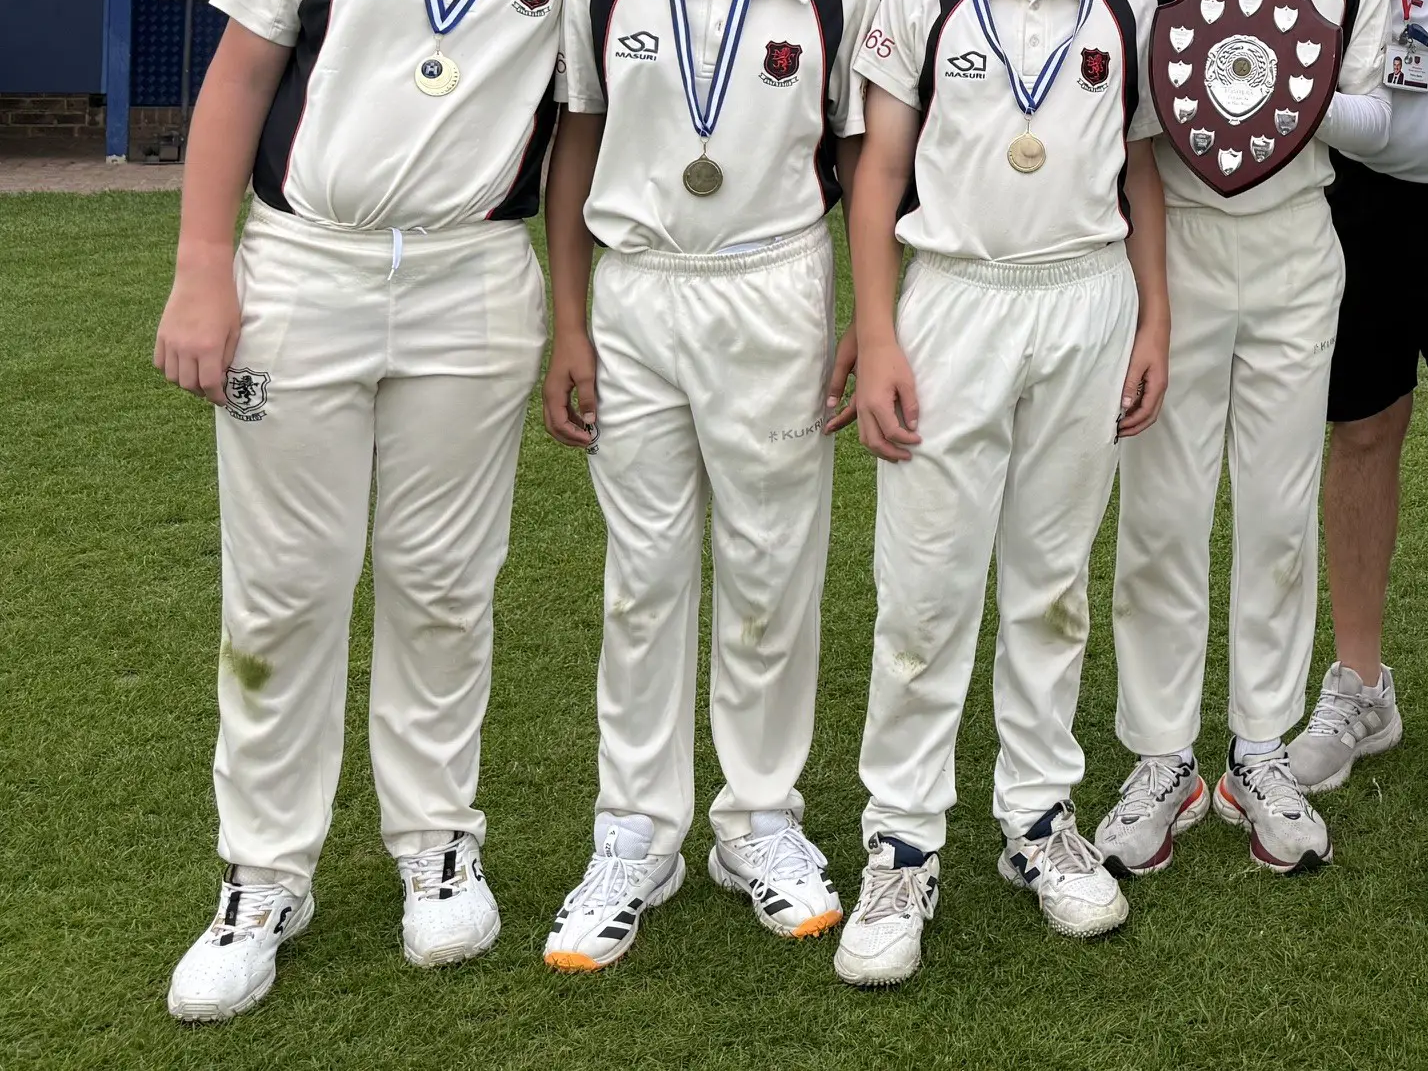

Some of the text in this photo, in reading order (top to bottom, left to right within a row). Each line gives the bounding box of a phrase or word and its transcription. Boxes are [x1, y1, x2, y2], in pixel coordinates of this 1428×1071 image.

[864, 29, 896, 59] 65
[615, 51, 657, 61] MASURI
[944, 71, 986, 80] MASURI
[781, 417, 824, 441] KUKRI
